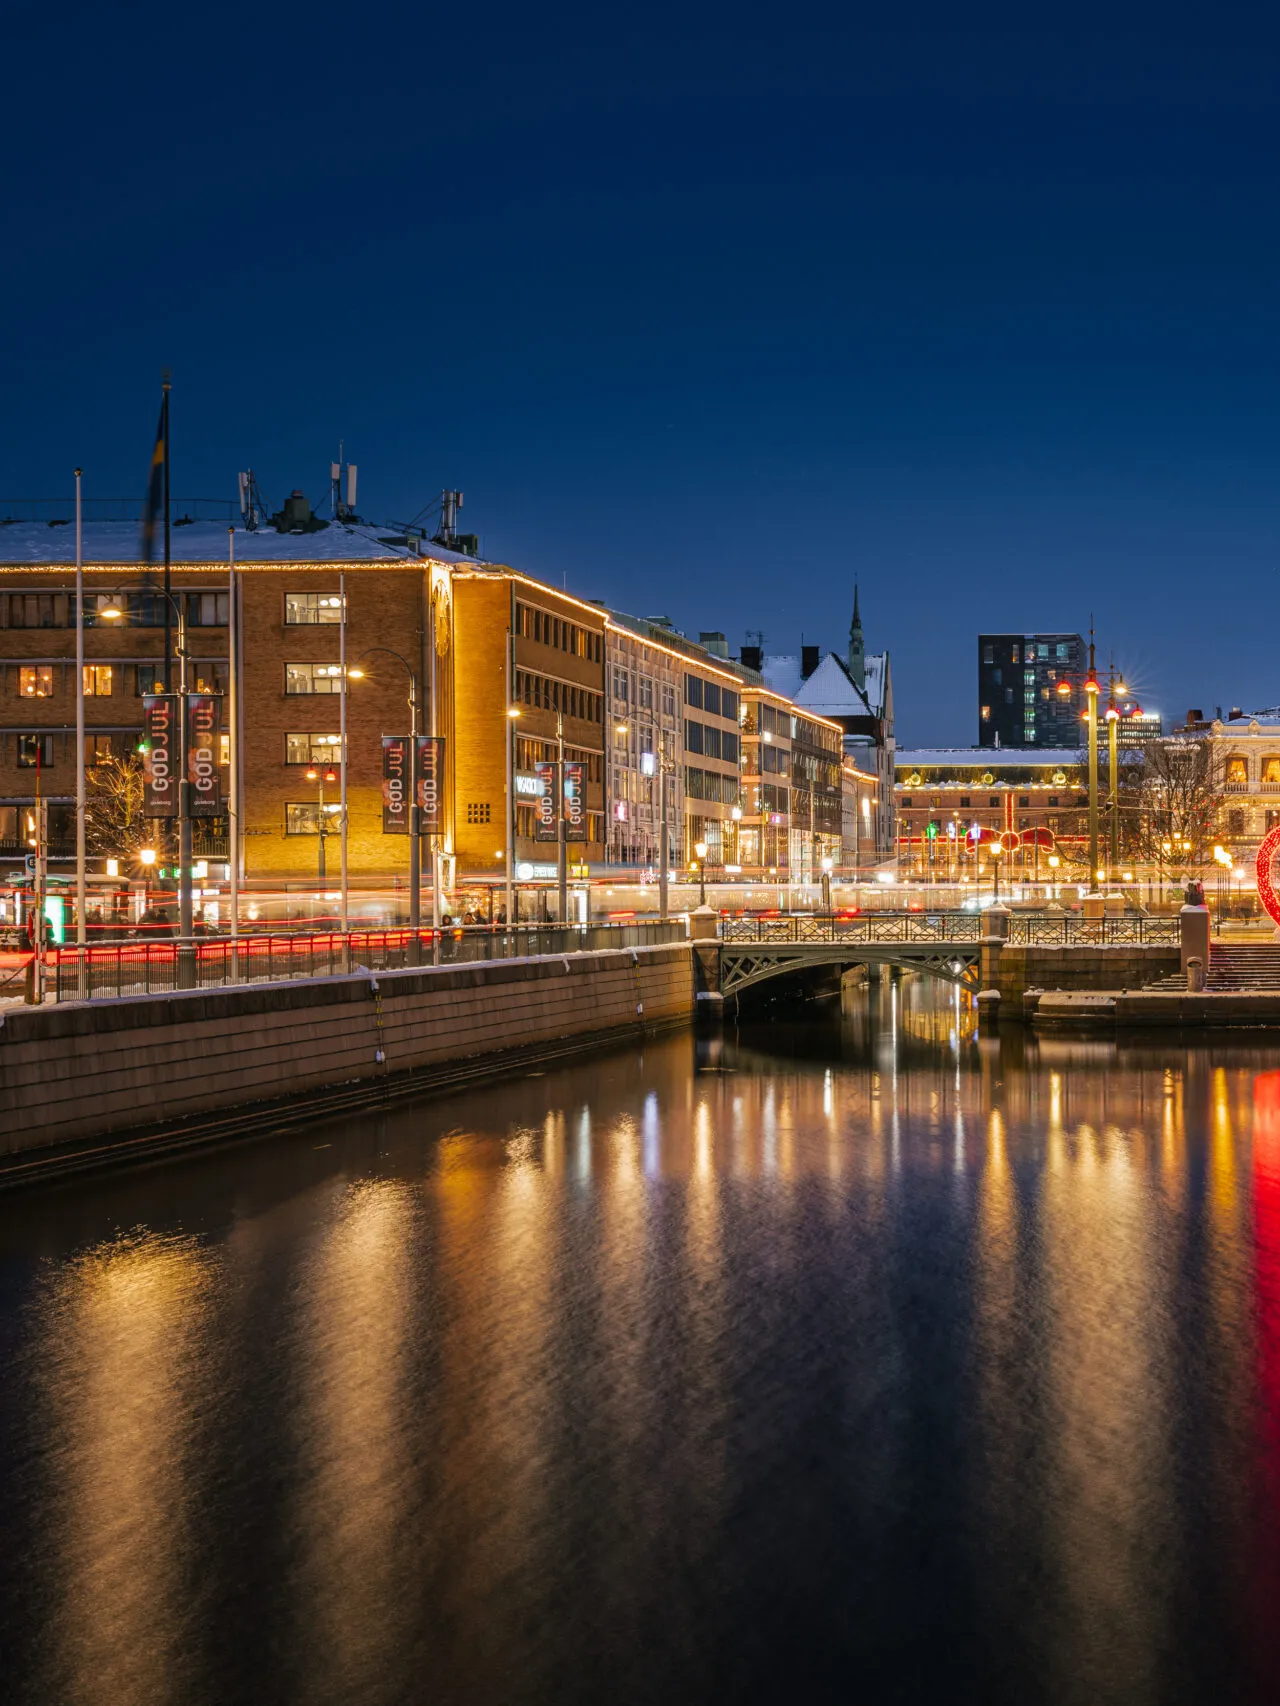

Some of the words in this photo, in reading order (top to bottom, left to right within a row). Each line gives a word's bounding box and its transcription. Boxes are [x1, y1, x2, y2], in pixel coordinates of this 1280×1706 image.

[152, 701, 169, 745] JUL
[195, 701, 214, 745] JUL
[151, 748, 169, 791] GOD
[195, 748, 213, 791] GOD
[389, 741, 403, 777] JUL
[423, 741, 438, 778] JUL
[389, 778, 403, 813] GOD
[423, 779, 437, 814] GOD
[540, 767, 553, 795] JUL
[569, 766, 582, 795] JUL
[541, 796, 553, 825] GOD
[569, 796, 581, 825] GOD
